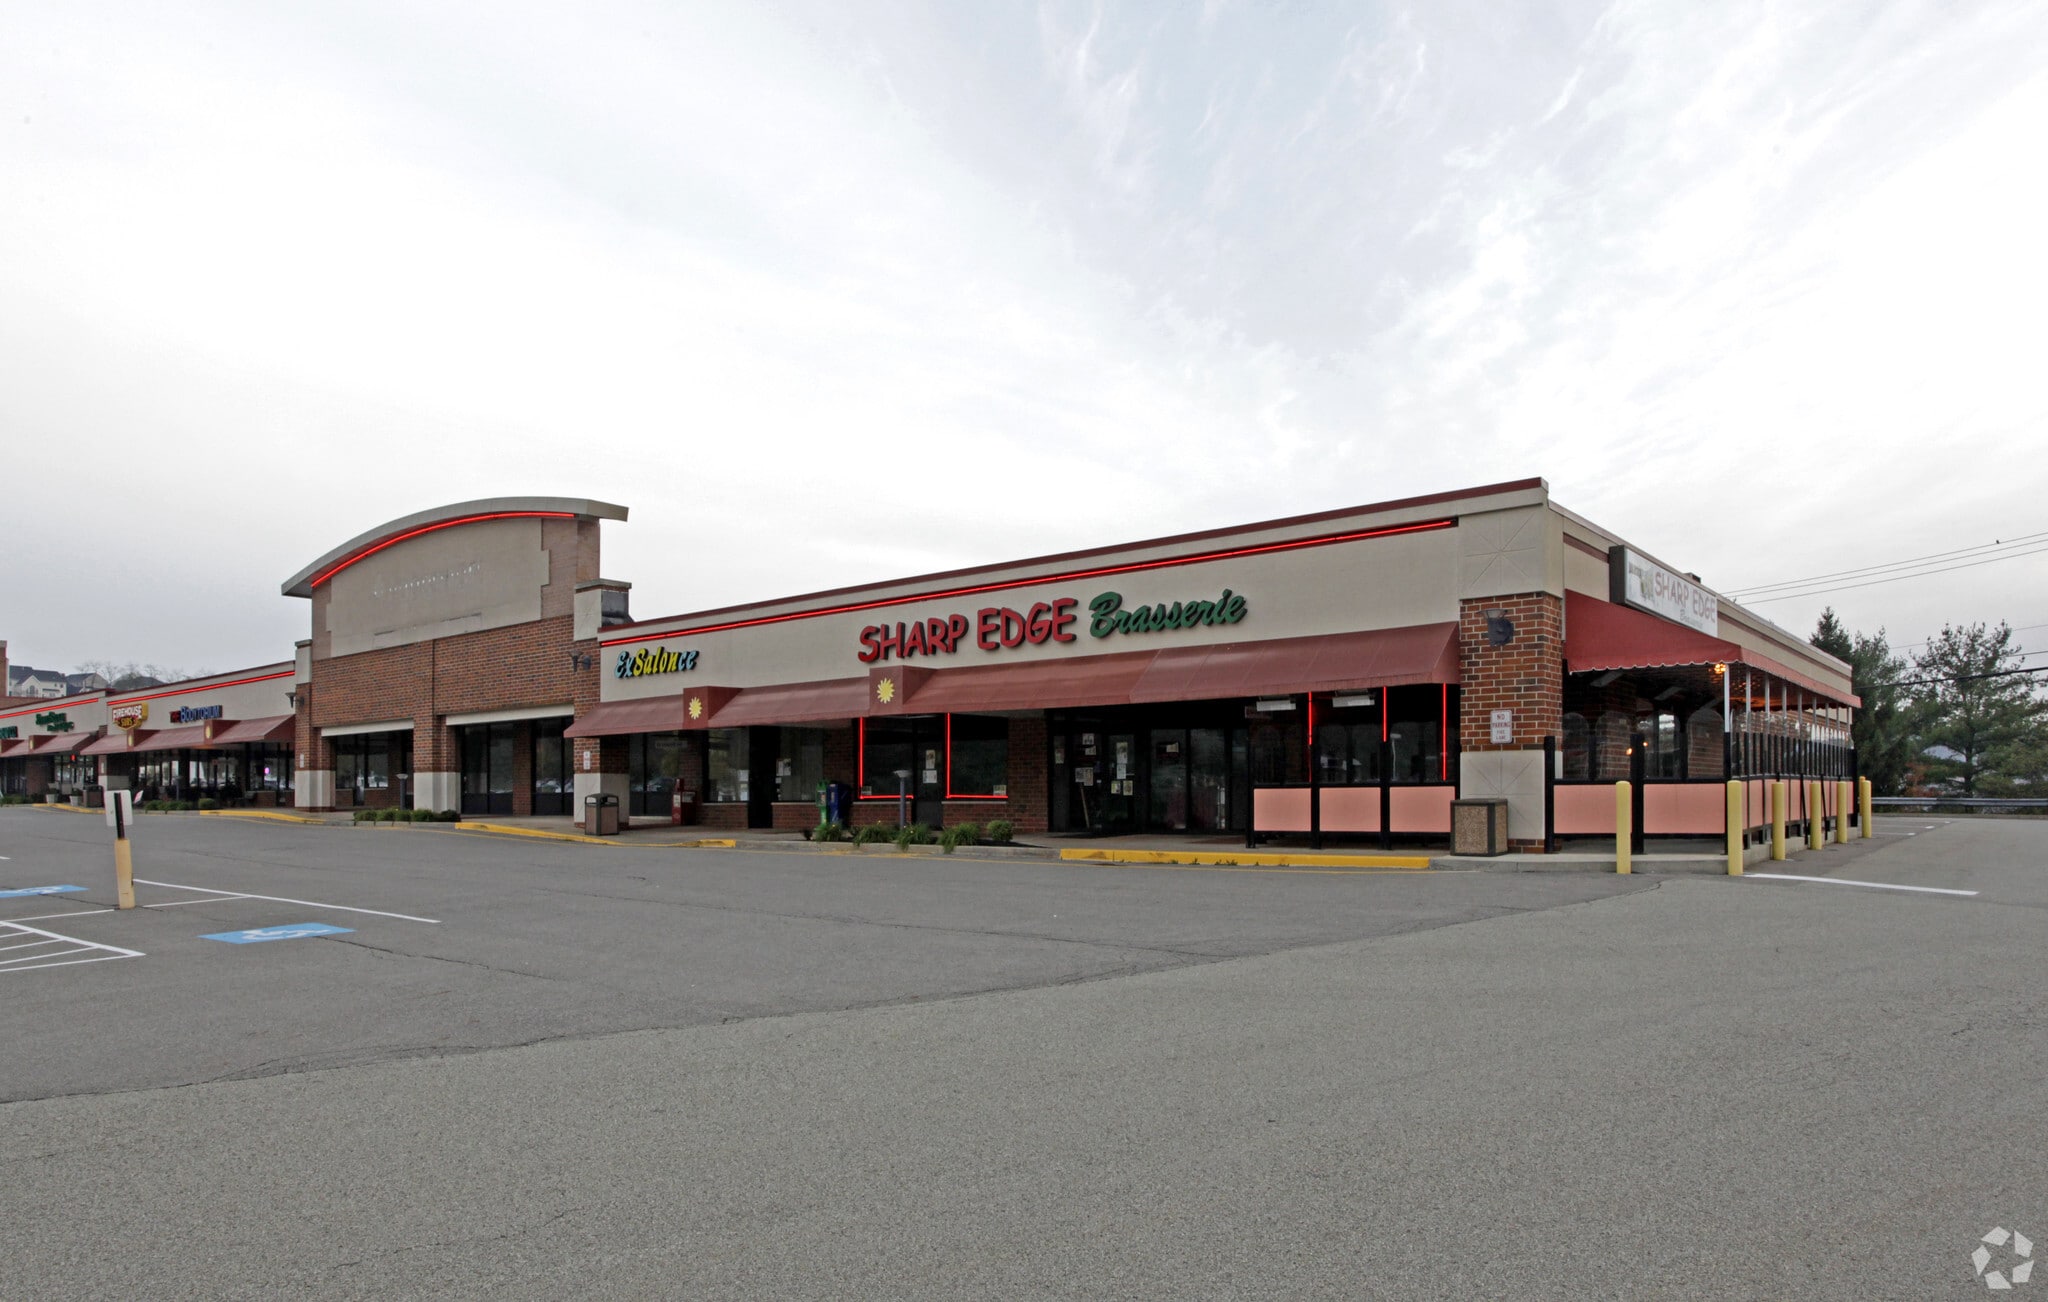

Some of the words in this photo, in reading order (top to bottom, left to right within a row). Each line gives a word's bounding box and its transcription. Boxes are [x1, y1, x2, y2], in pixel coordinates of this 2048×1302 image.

[1655, 572, 1689, 608] SHARP
[1693, 590, 1716, 623] EDGE
[857, 614, 968, 663] SHARP
[977, 598, 1076, 650] EDGE
[1089, 589, 1247, 638] Brasserie
[614, 646, 699, 678] ExSalonce
[113, 705, 142, 719] FIREHOUSE
